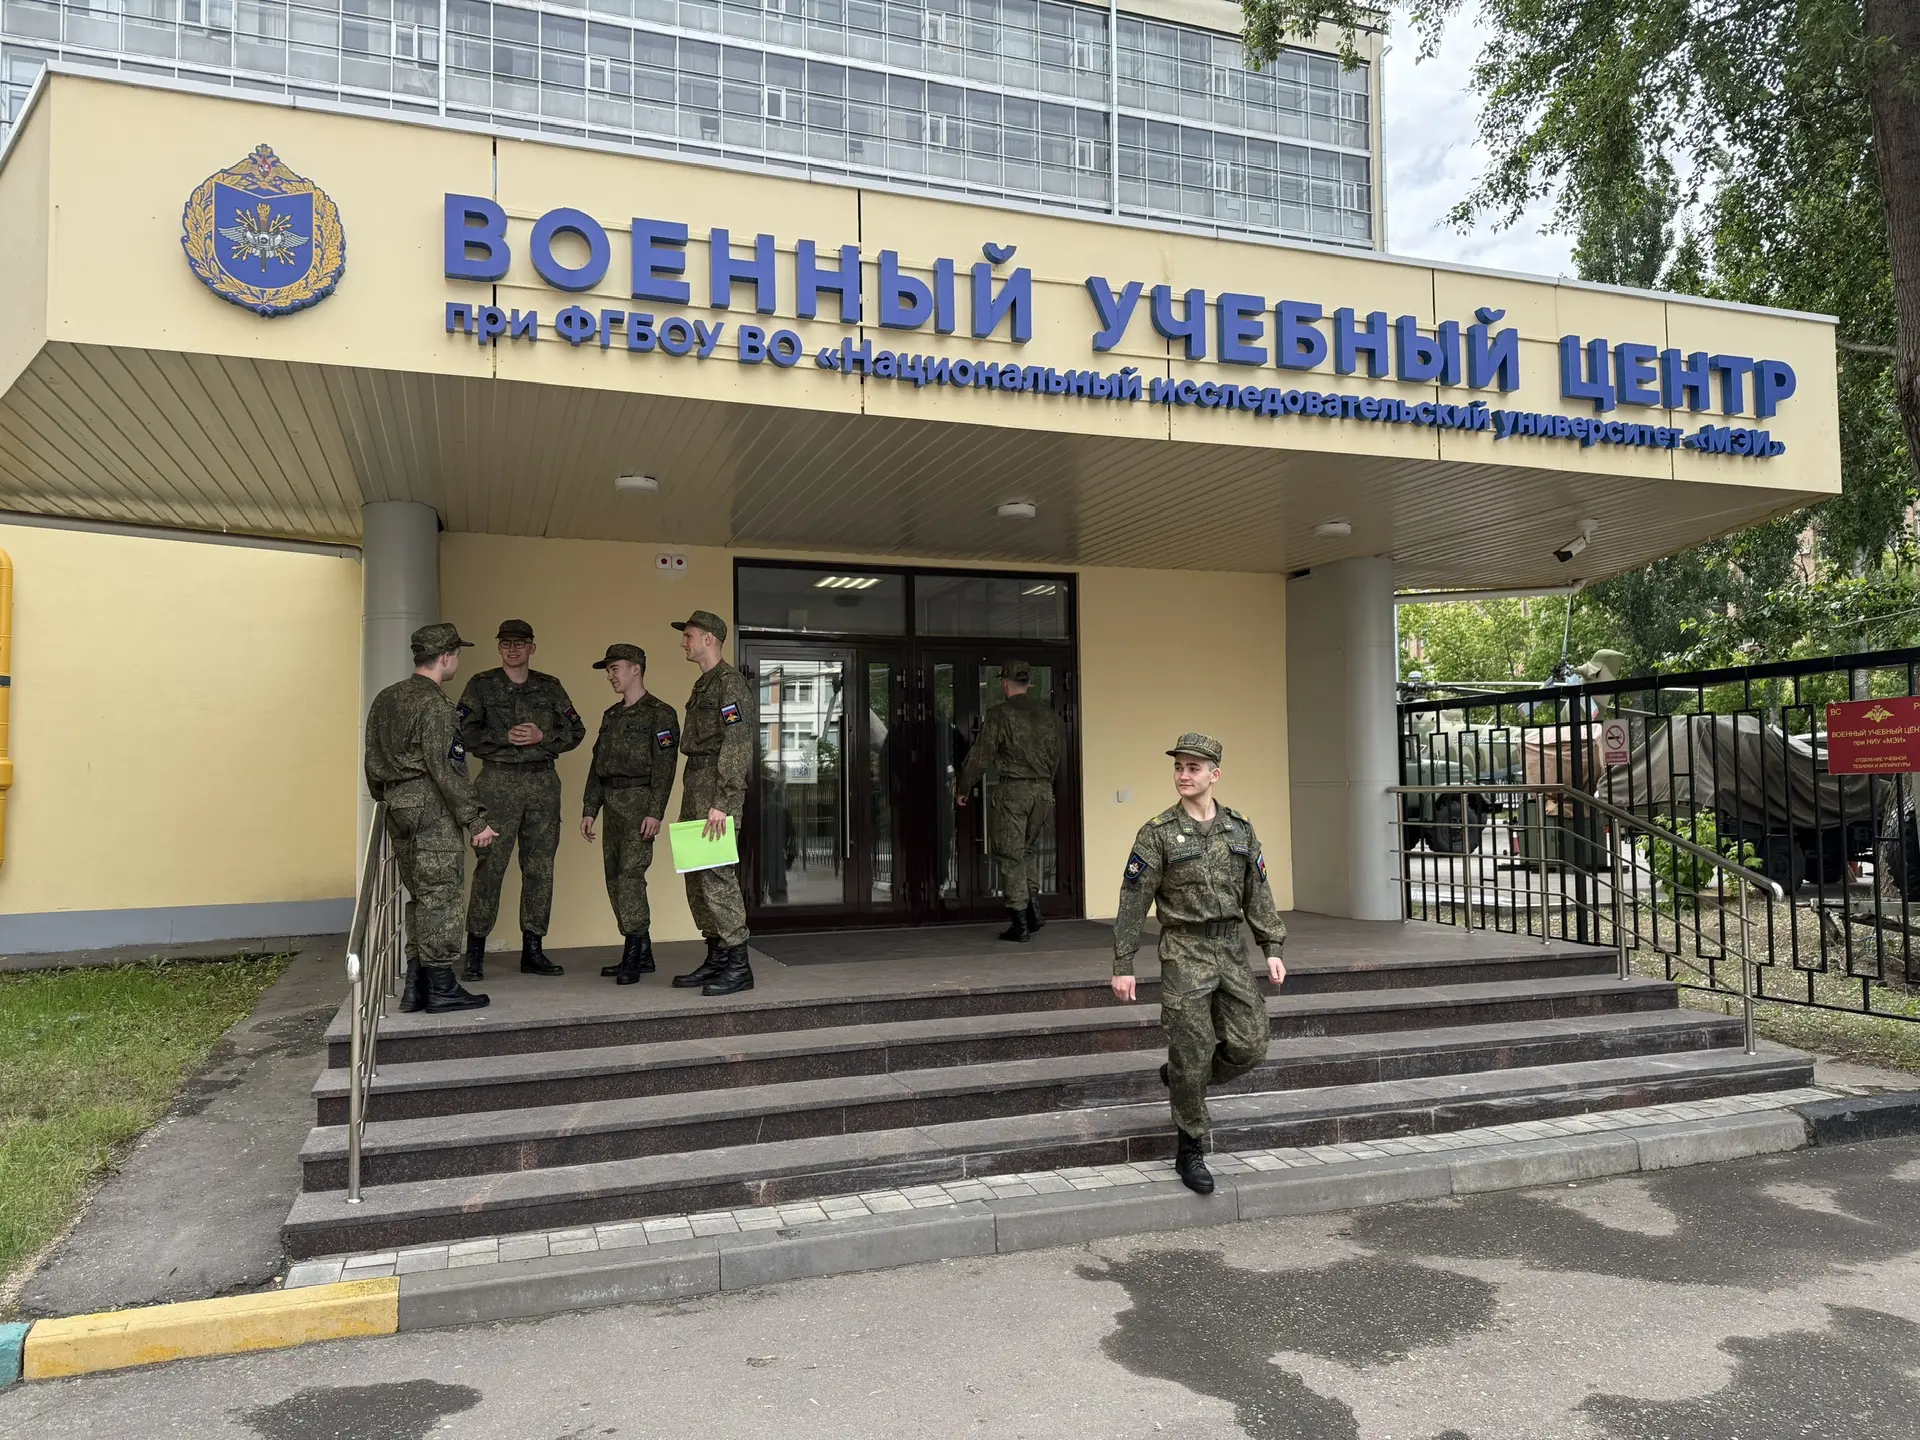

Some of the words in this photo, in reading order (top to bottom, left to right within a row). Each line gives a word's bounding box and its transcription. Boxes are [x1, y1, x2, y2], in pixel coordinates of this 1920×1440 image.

[445, 193, 1031, 345] ВОЕННЫЙ
[1085, 276, 1519, 392] УЧЕБНЫЙ
[1560, 335, 1796, 419] ЦЕНТР
[446, 302, 537, 346] при
[555, 305, 724, 359] ФГБОУ
[738, 325, 802, 368] ВО
[814, 337, 1142, 400] «Национальный
[1150, 377, 1489, 431] исследовательский
[1491, 410, 1683, 448] университет
[1684, 425, 1786, 457] «МЭИ»
[1830, 708, 1841, 716] ВС
[1913, 702, 1920, 710] Р
[1831, 729, 1867, 738] ВОЕННЫЙ
[1868, 726, 1903, 736] УЧЕБНЫЙ
[1904, 726, 1920, 735] ЦЕН
